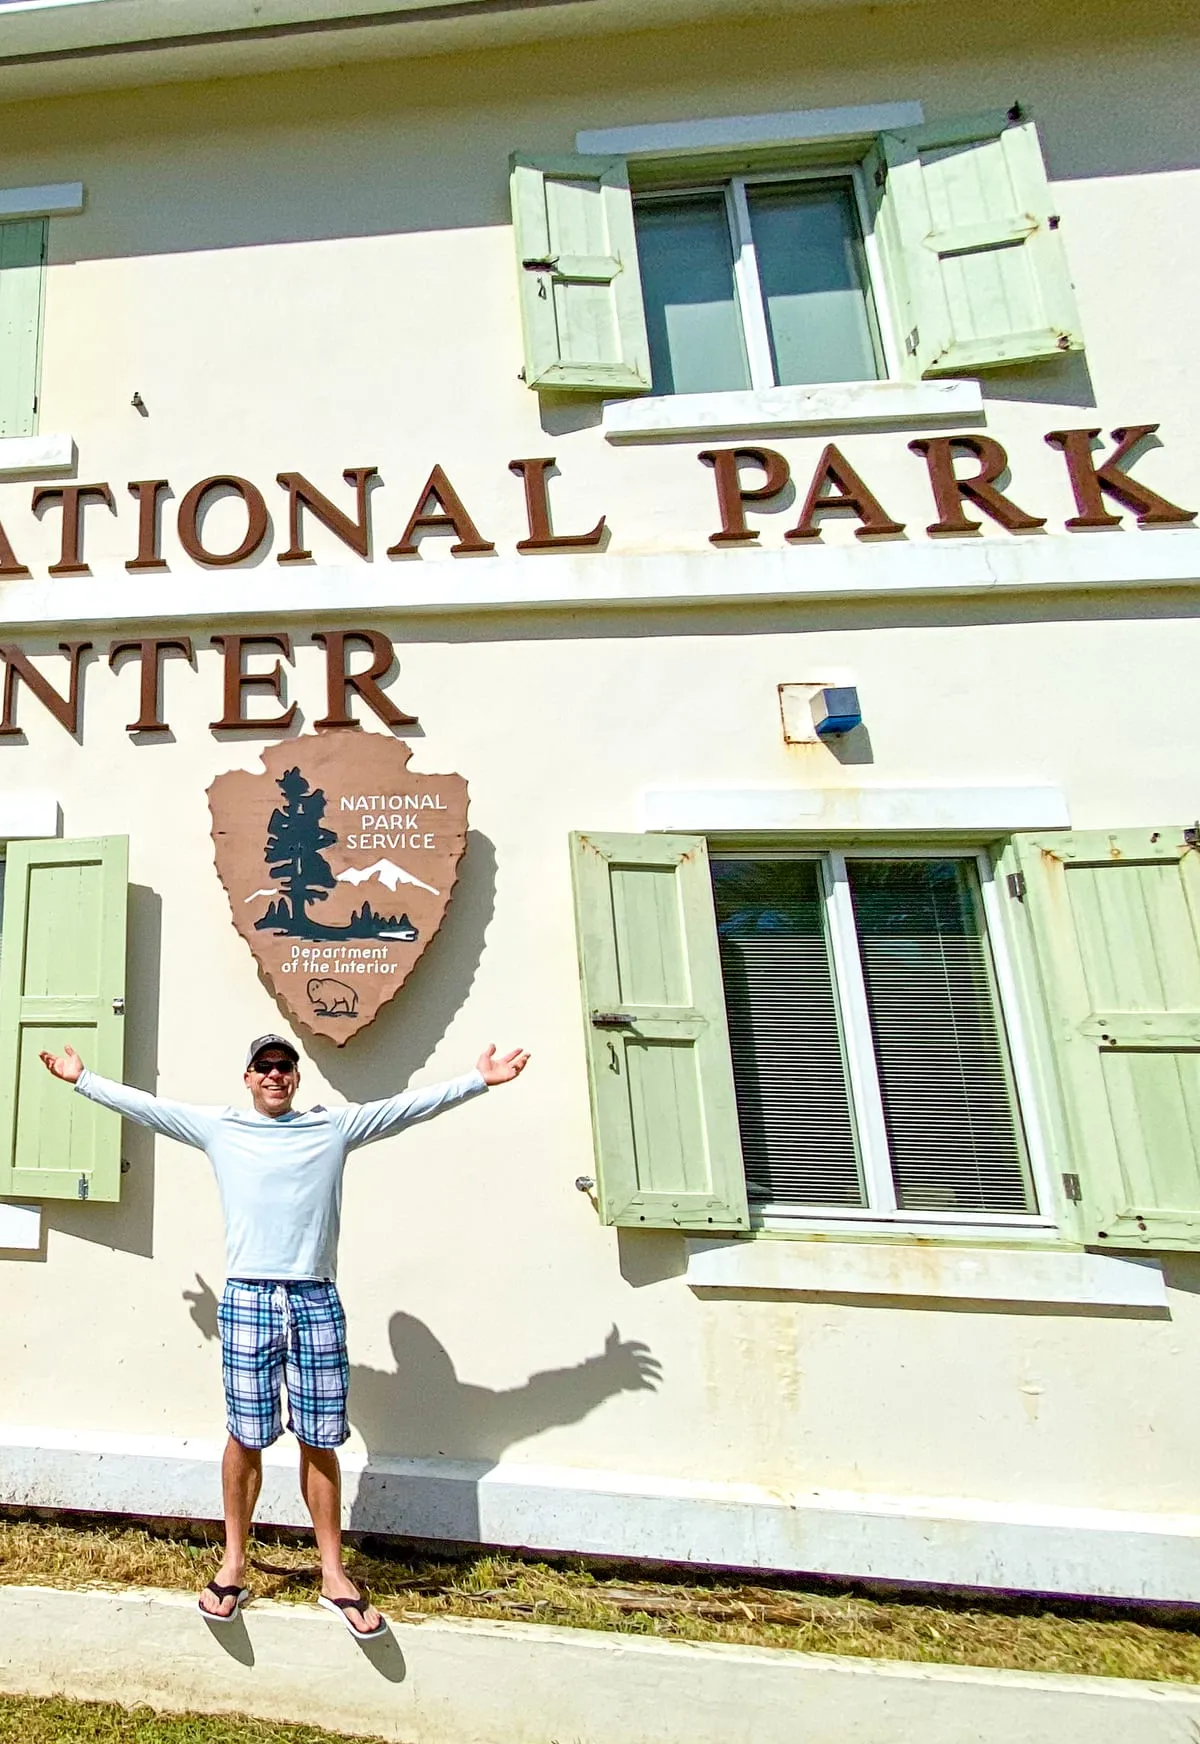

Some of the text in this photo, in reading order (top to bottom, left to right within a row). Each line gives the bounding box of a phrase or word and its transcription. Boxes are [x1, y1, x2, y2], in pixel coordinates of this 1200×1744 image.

[697, 423, 1200, 543] PARK
[340, 794, 447, 811] NATIONAL
[362, 814, 418, 830] PARK
[346, 833, 436, 849] SERVICE
[291, 945, 388, 962] Department
[281, 960, 398, 975] of the Interior
